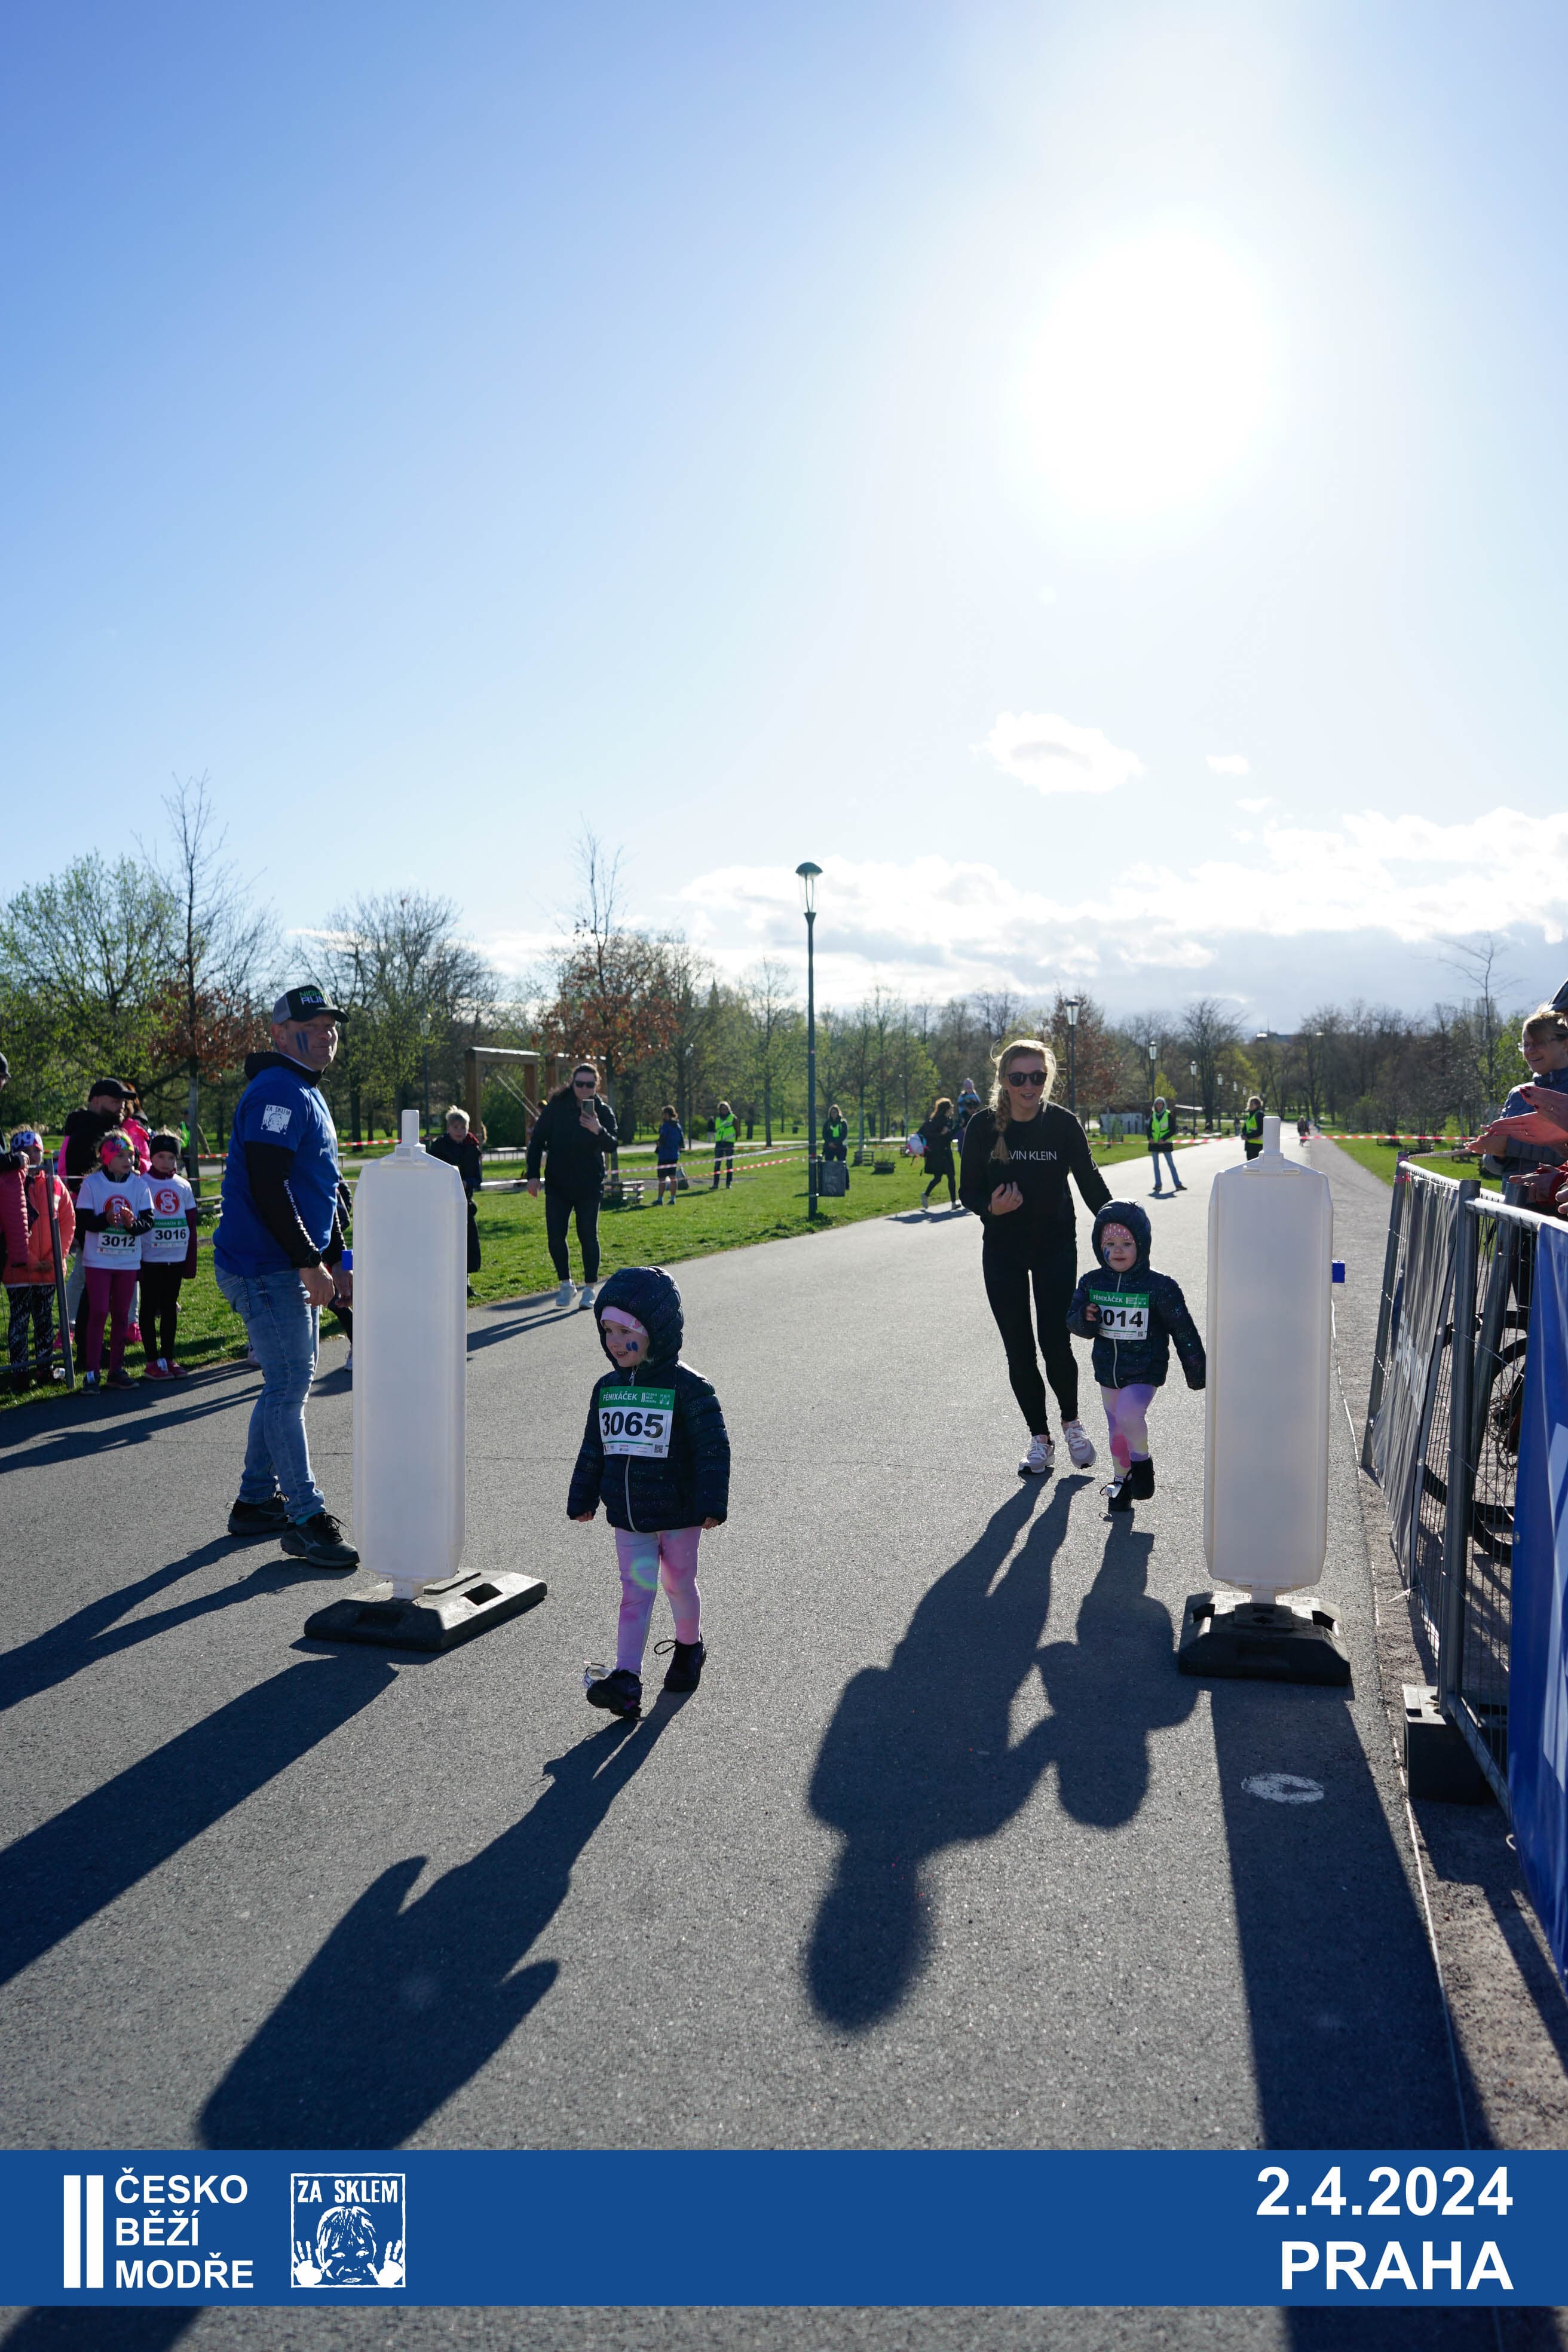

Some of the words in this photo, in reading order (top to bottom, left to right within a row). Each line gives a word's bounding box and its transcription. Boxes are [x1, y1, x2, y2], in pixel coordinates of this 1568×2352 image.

[1029, 1150, 1057, 1160] KLEIN
[155, 1229, 186, 1240] 3016
[102, 1235, 136, 1247] 3012
[1093, 1294, 1123, 1303] FÉNIXÁČEK
[1100, 1309, 1143, 1328] 014
[603, 1391, 638, 1401] FÉNIXÁČEK
[602, 1411, 664, 1438] 3065
